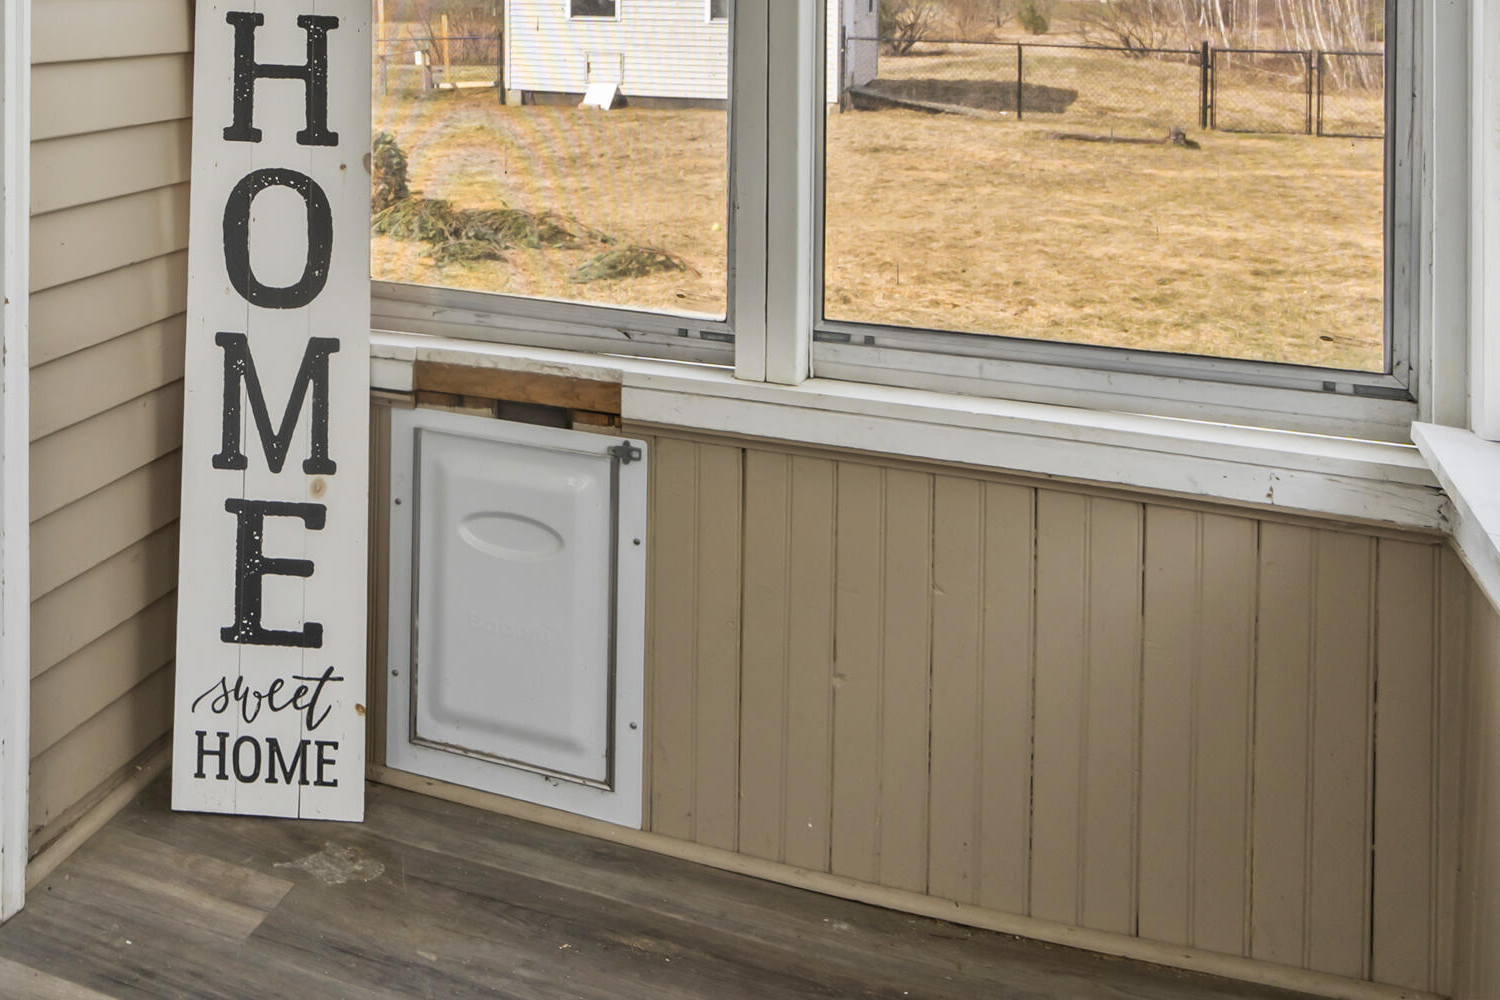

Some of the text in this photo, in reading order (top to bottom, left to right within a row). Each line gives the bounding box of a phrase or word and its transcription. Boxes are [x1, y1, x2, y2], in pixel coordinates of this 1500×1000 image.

[211, 11, 340, 648] HOME
[191, 665, 344, 731] sweet
[194, 730, 339, 787] HOME
